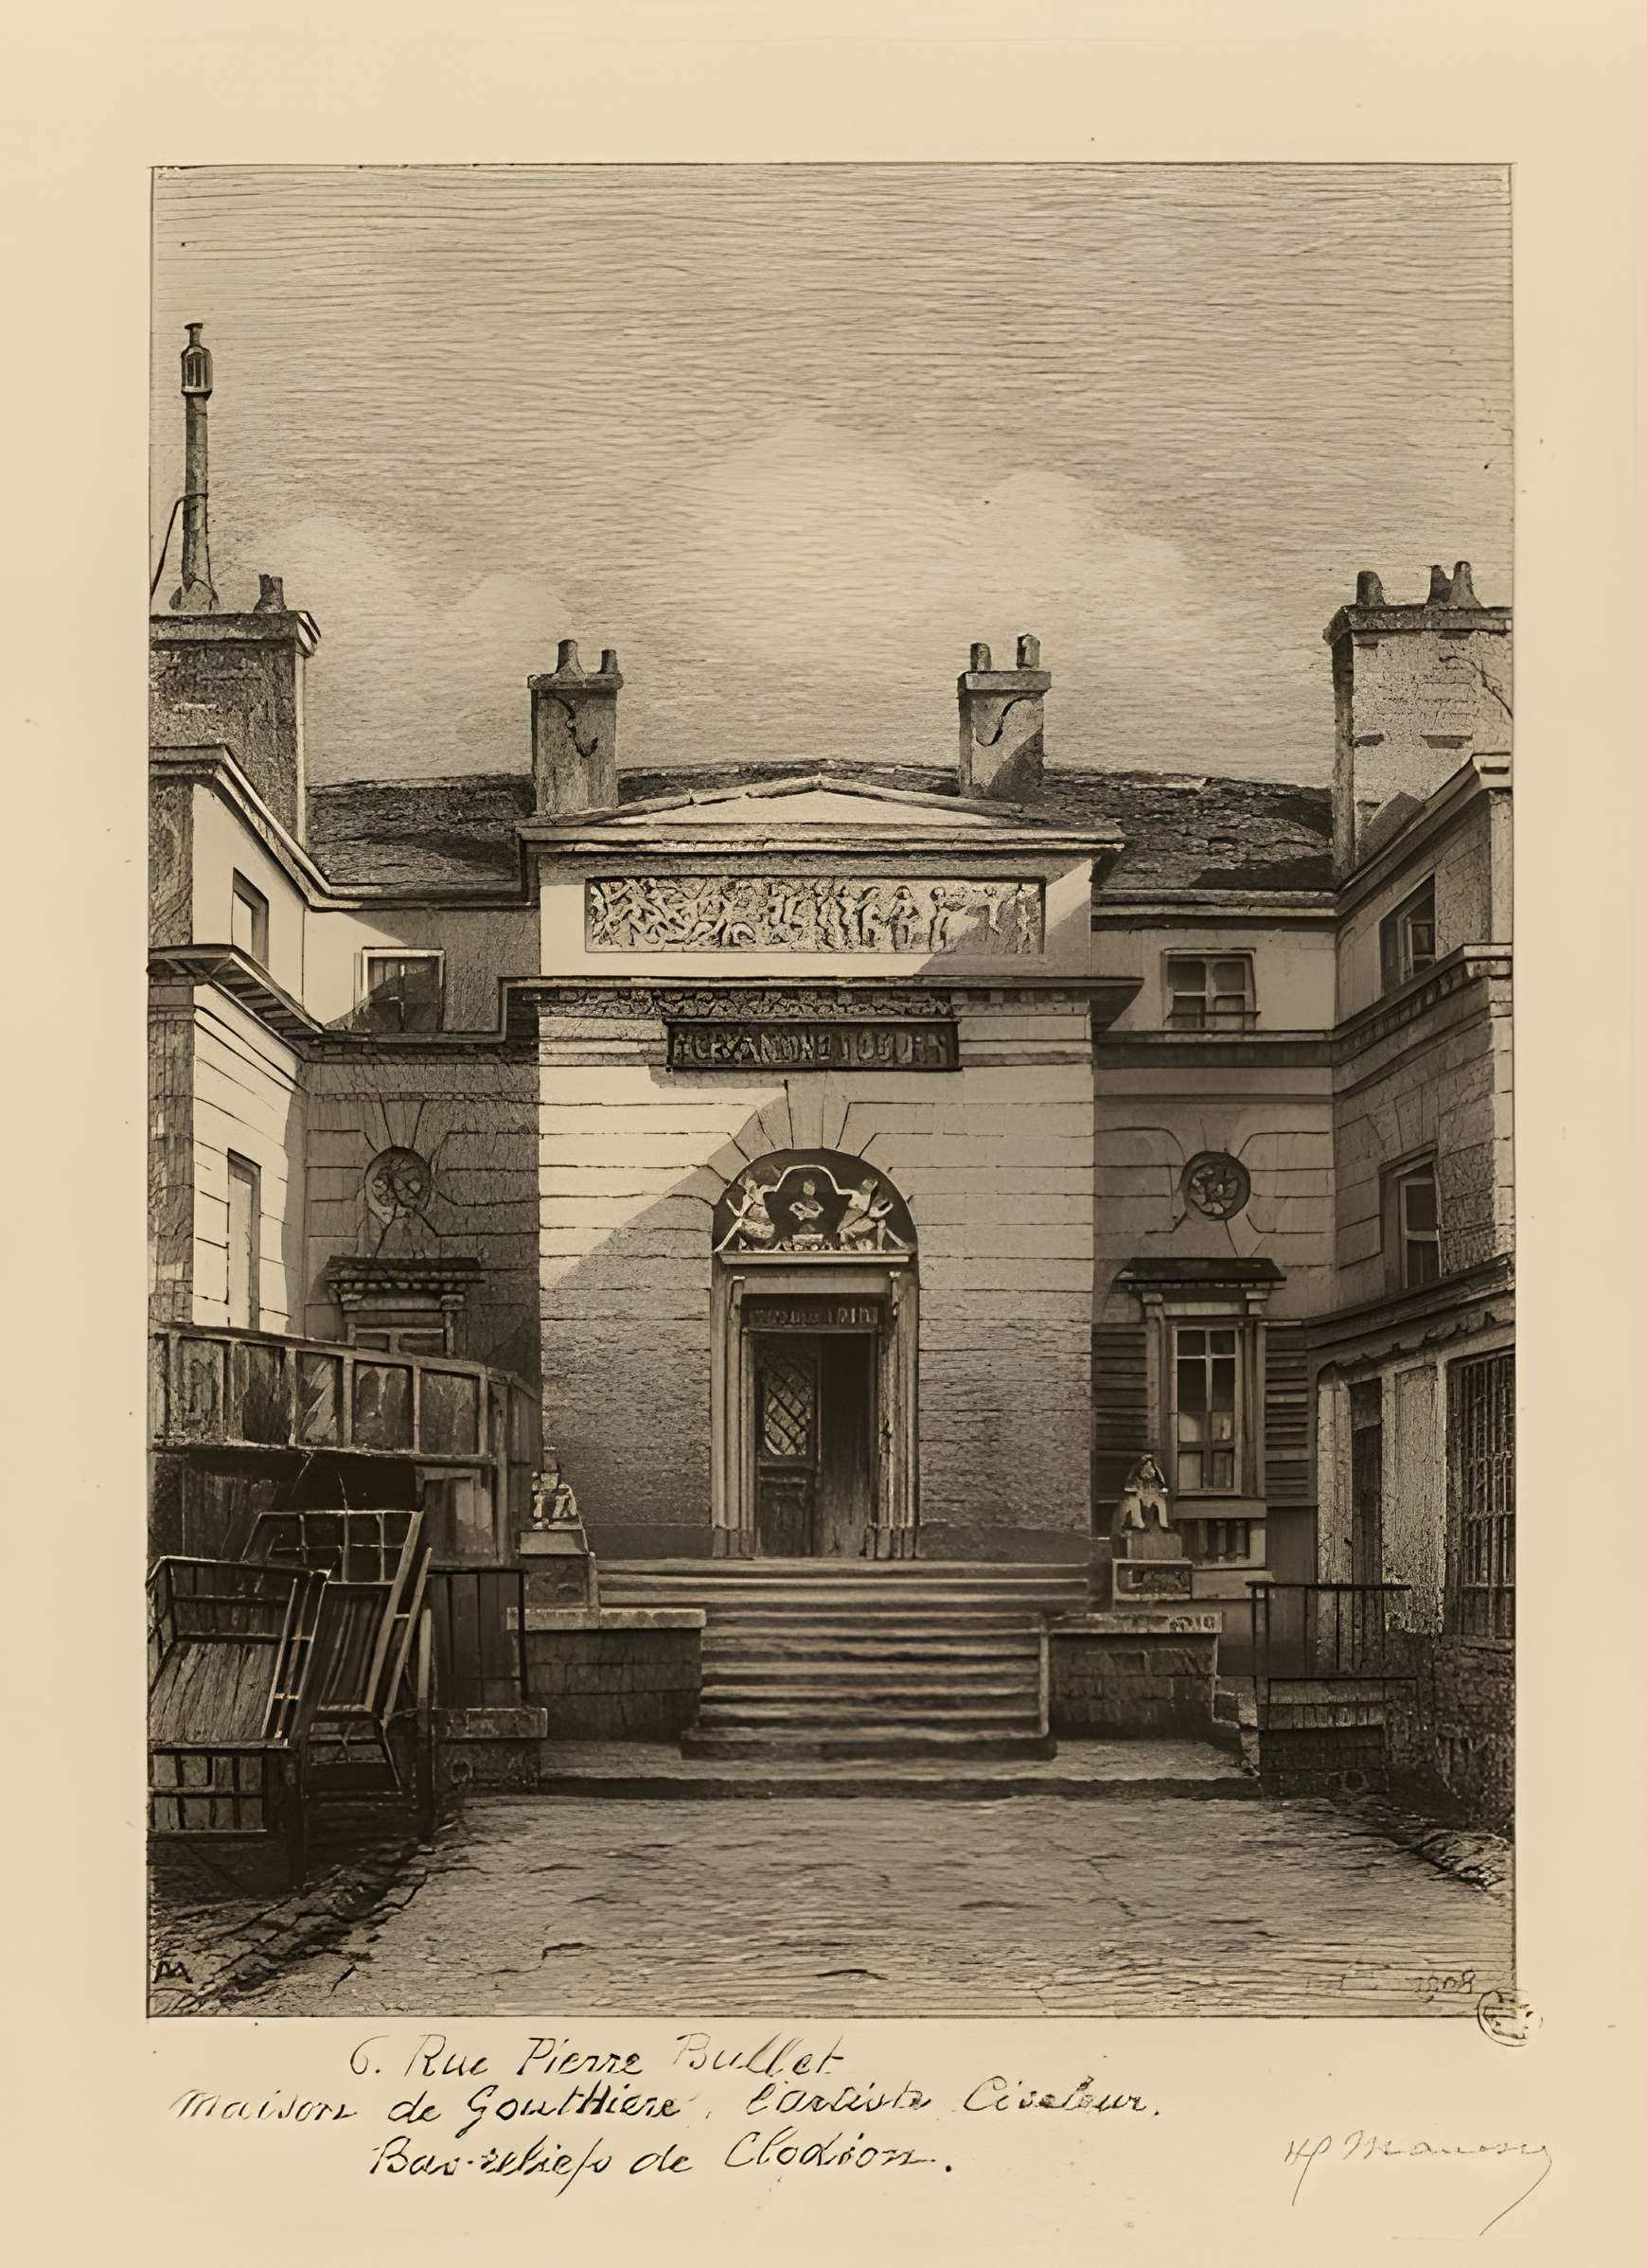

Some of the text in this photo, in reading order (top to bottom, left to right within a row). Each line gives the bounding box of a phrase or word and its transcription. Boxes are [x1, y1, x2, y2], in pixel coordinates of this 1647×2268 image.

[403, 2032, 489, 2077] Rue
[515, 2036, 645, 2076] Pierre
[672, 2032, 844, 2078] Bullet
[387, 2089, 442, 2124] de
[629, 2143, 694, 2176] de
